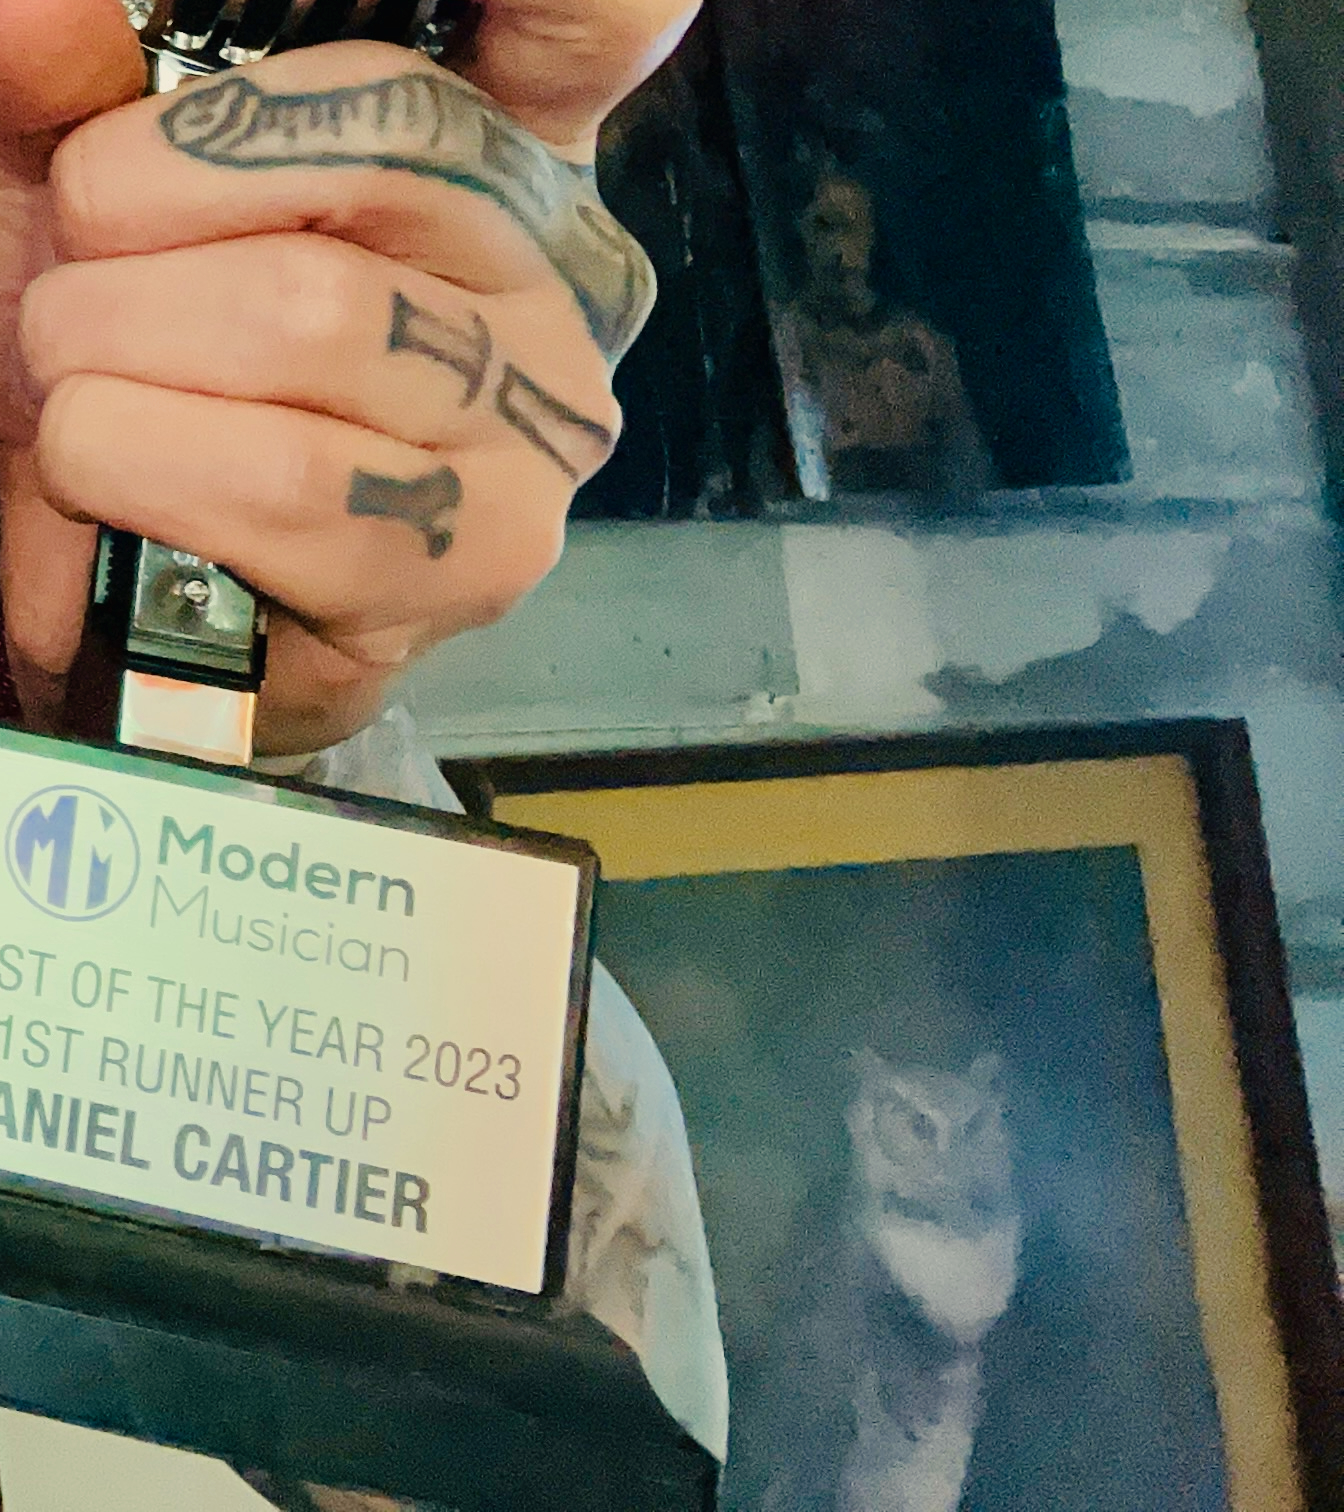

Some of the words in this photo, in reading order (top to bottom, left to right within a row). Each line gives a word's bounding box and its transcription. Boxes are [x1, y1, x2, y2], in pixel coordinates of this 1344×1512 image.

[157, 815, 416, 918] Modern
[149, 874, 412, 983] Musician
[71, 960, 132, 1013] OF
[148, 975, 240, 1040] THE
[257, 999, 384, 1073] YEAR
[403, 1033, 522, 1102] 2023
[98, 1036, 304, 1126] RUNNER
[325, 1087, 392, 1142] UP
[173, 1123, 432, 1235] CARTIER
